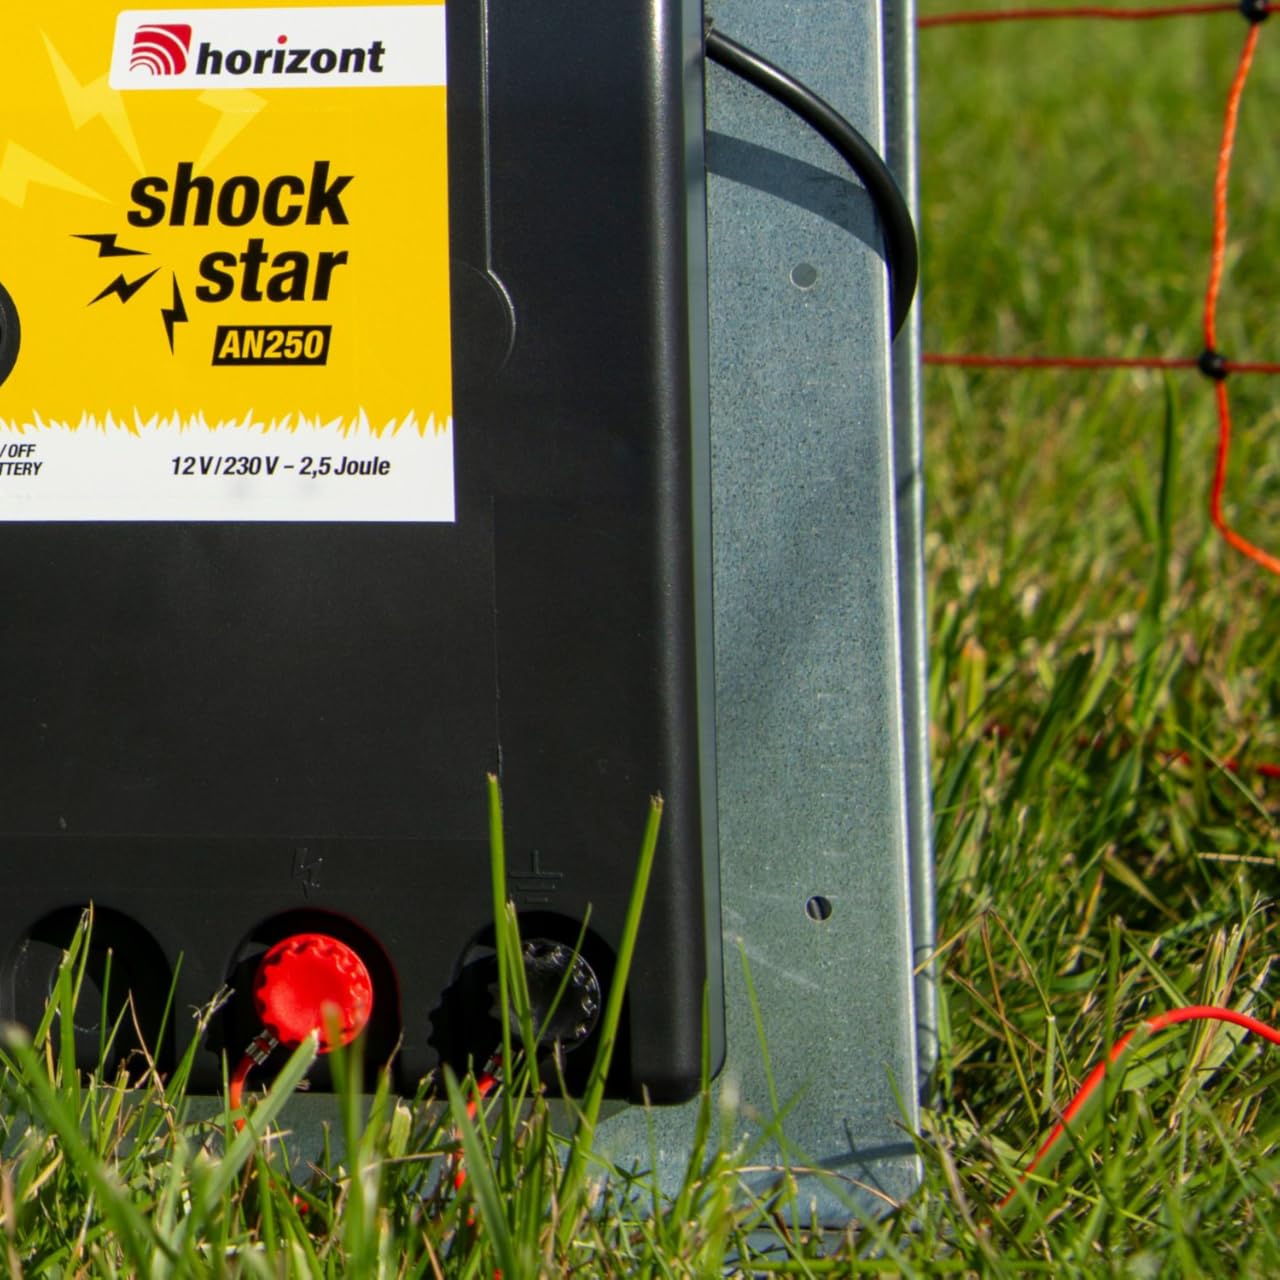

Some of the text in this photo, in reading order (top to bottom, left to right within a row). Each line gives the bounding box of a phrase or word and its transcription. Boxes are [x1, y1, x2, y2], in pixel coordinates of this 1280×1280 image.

[196, 35, 386, 75] horizont
[128, 161, 354, 227] shock
[196, 239, 348, 302] star
[219, 330, 324, 359] AN250
